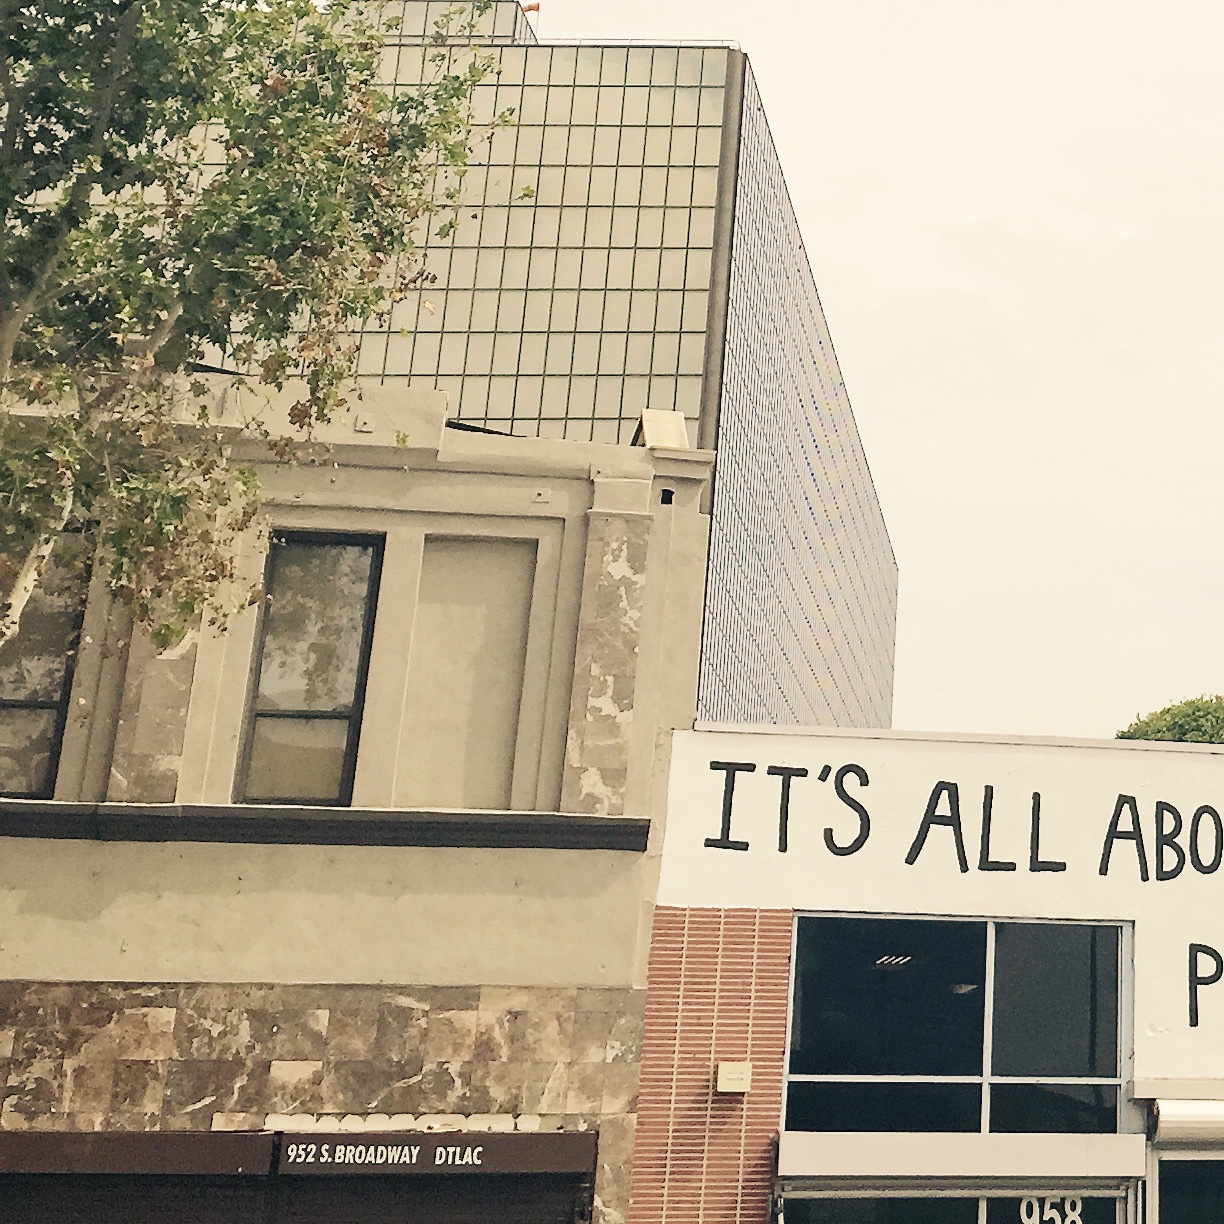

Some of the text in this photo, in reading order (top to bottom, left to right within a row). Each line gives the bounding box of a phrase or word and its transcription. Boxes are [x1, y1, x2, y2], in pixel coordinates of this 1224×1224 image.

[703, 760, 871, 857] IT'S
[904, 780, 1067, 874] ALL
[286, 1143, 317, 1164] 952
[434, 1146, 484, 1166] DTLAC
[1019, 1196, 1083, 1224] 958
